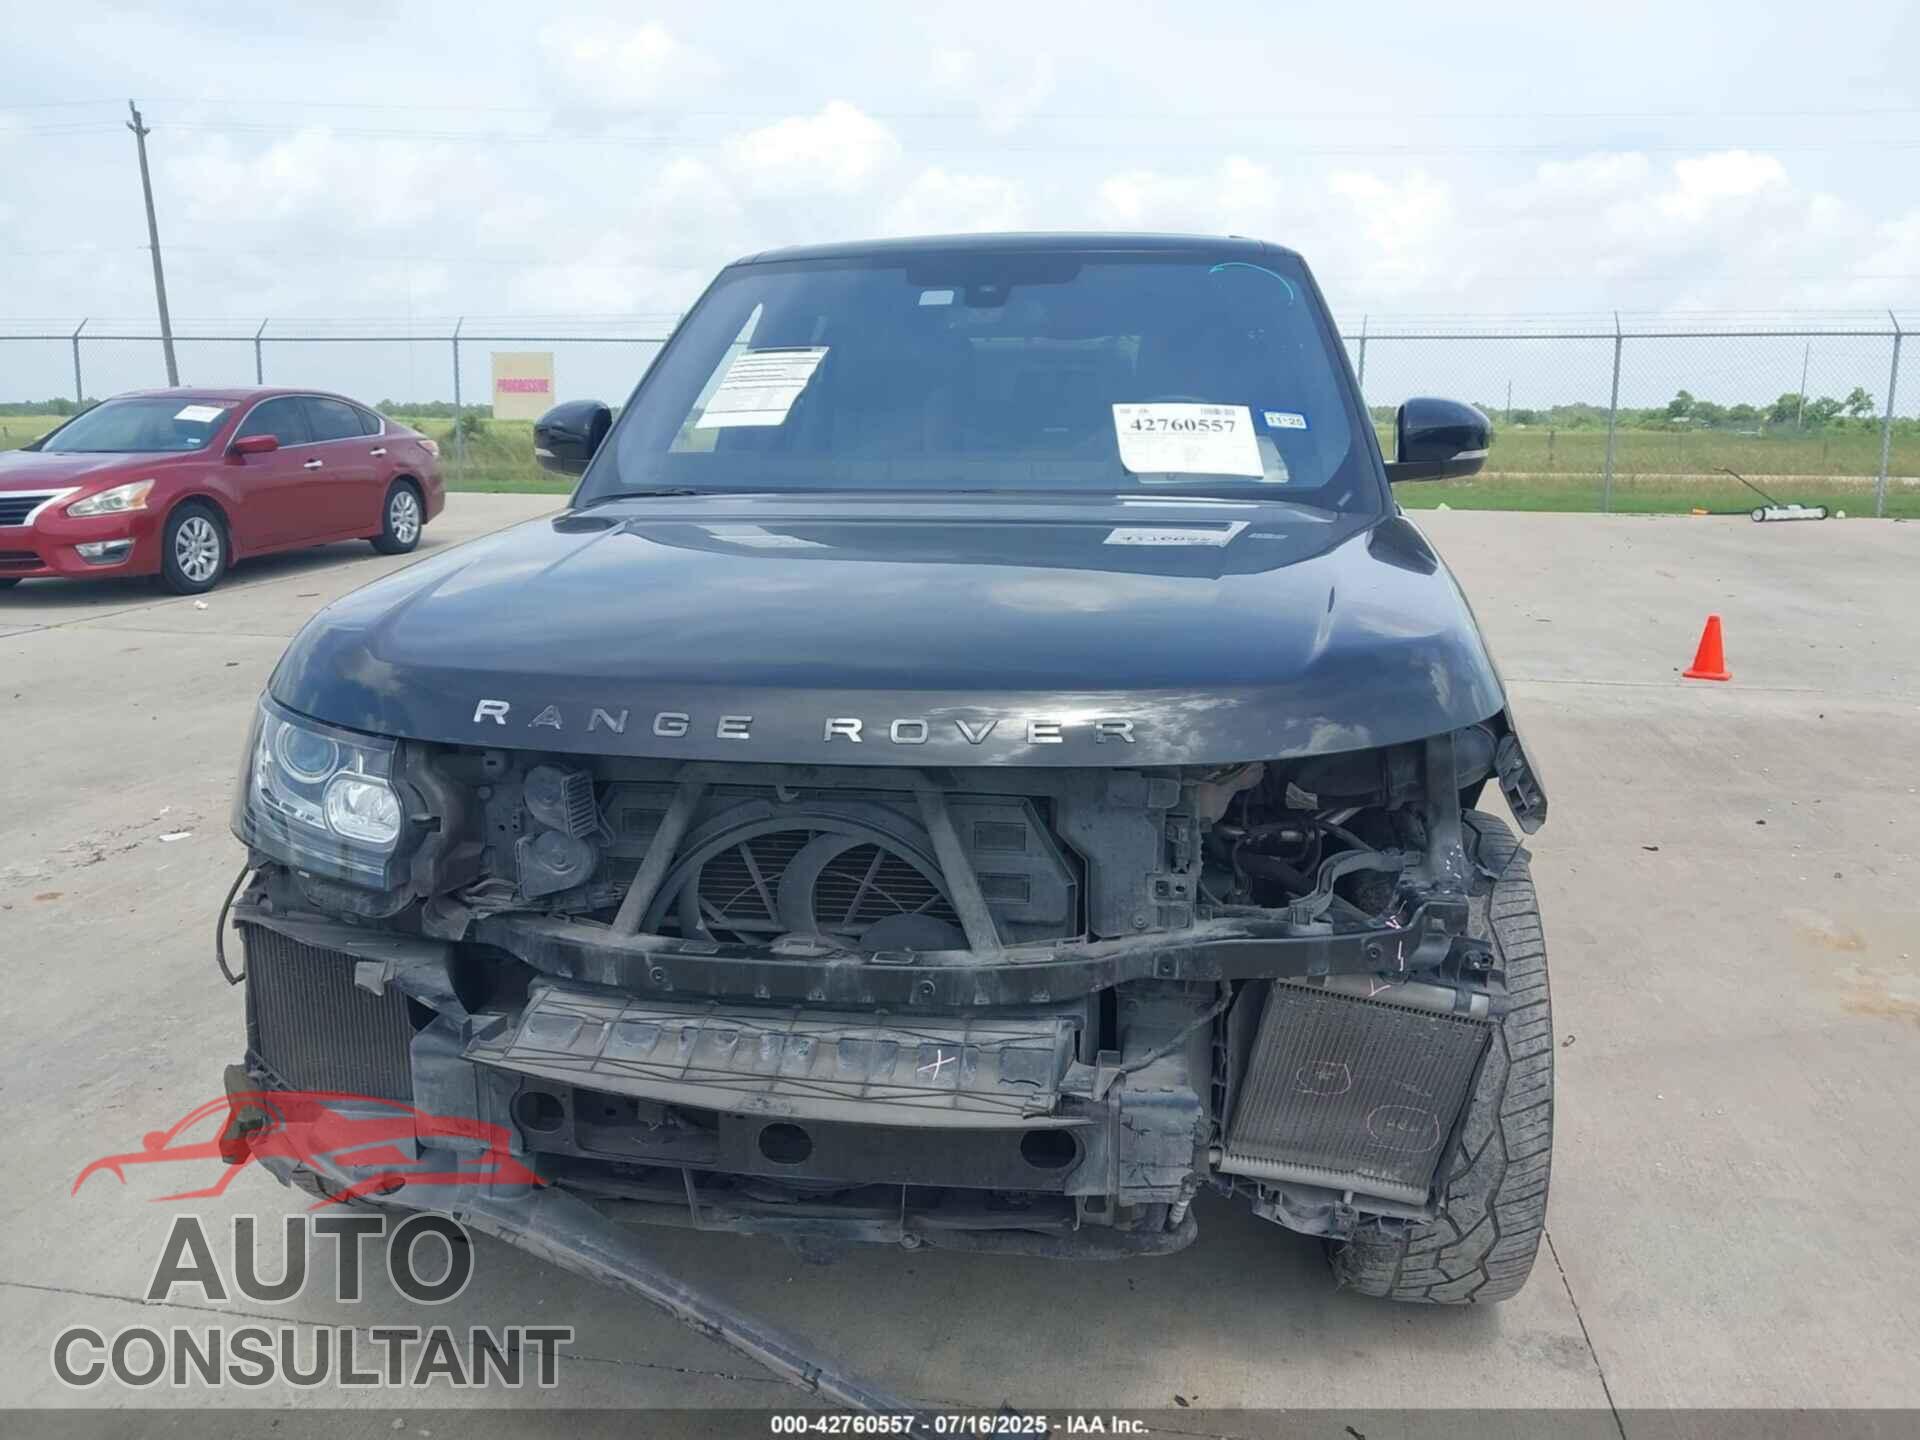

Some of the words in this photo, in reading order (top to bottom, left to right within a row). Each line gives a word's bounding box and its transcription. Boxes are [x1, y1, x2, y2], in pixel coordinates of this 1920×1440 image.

[1130, 418, 1236, 432] 42760557
[473, 699, 752, 739] RANGE
[823, 717, 1136, 744] ROVER
